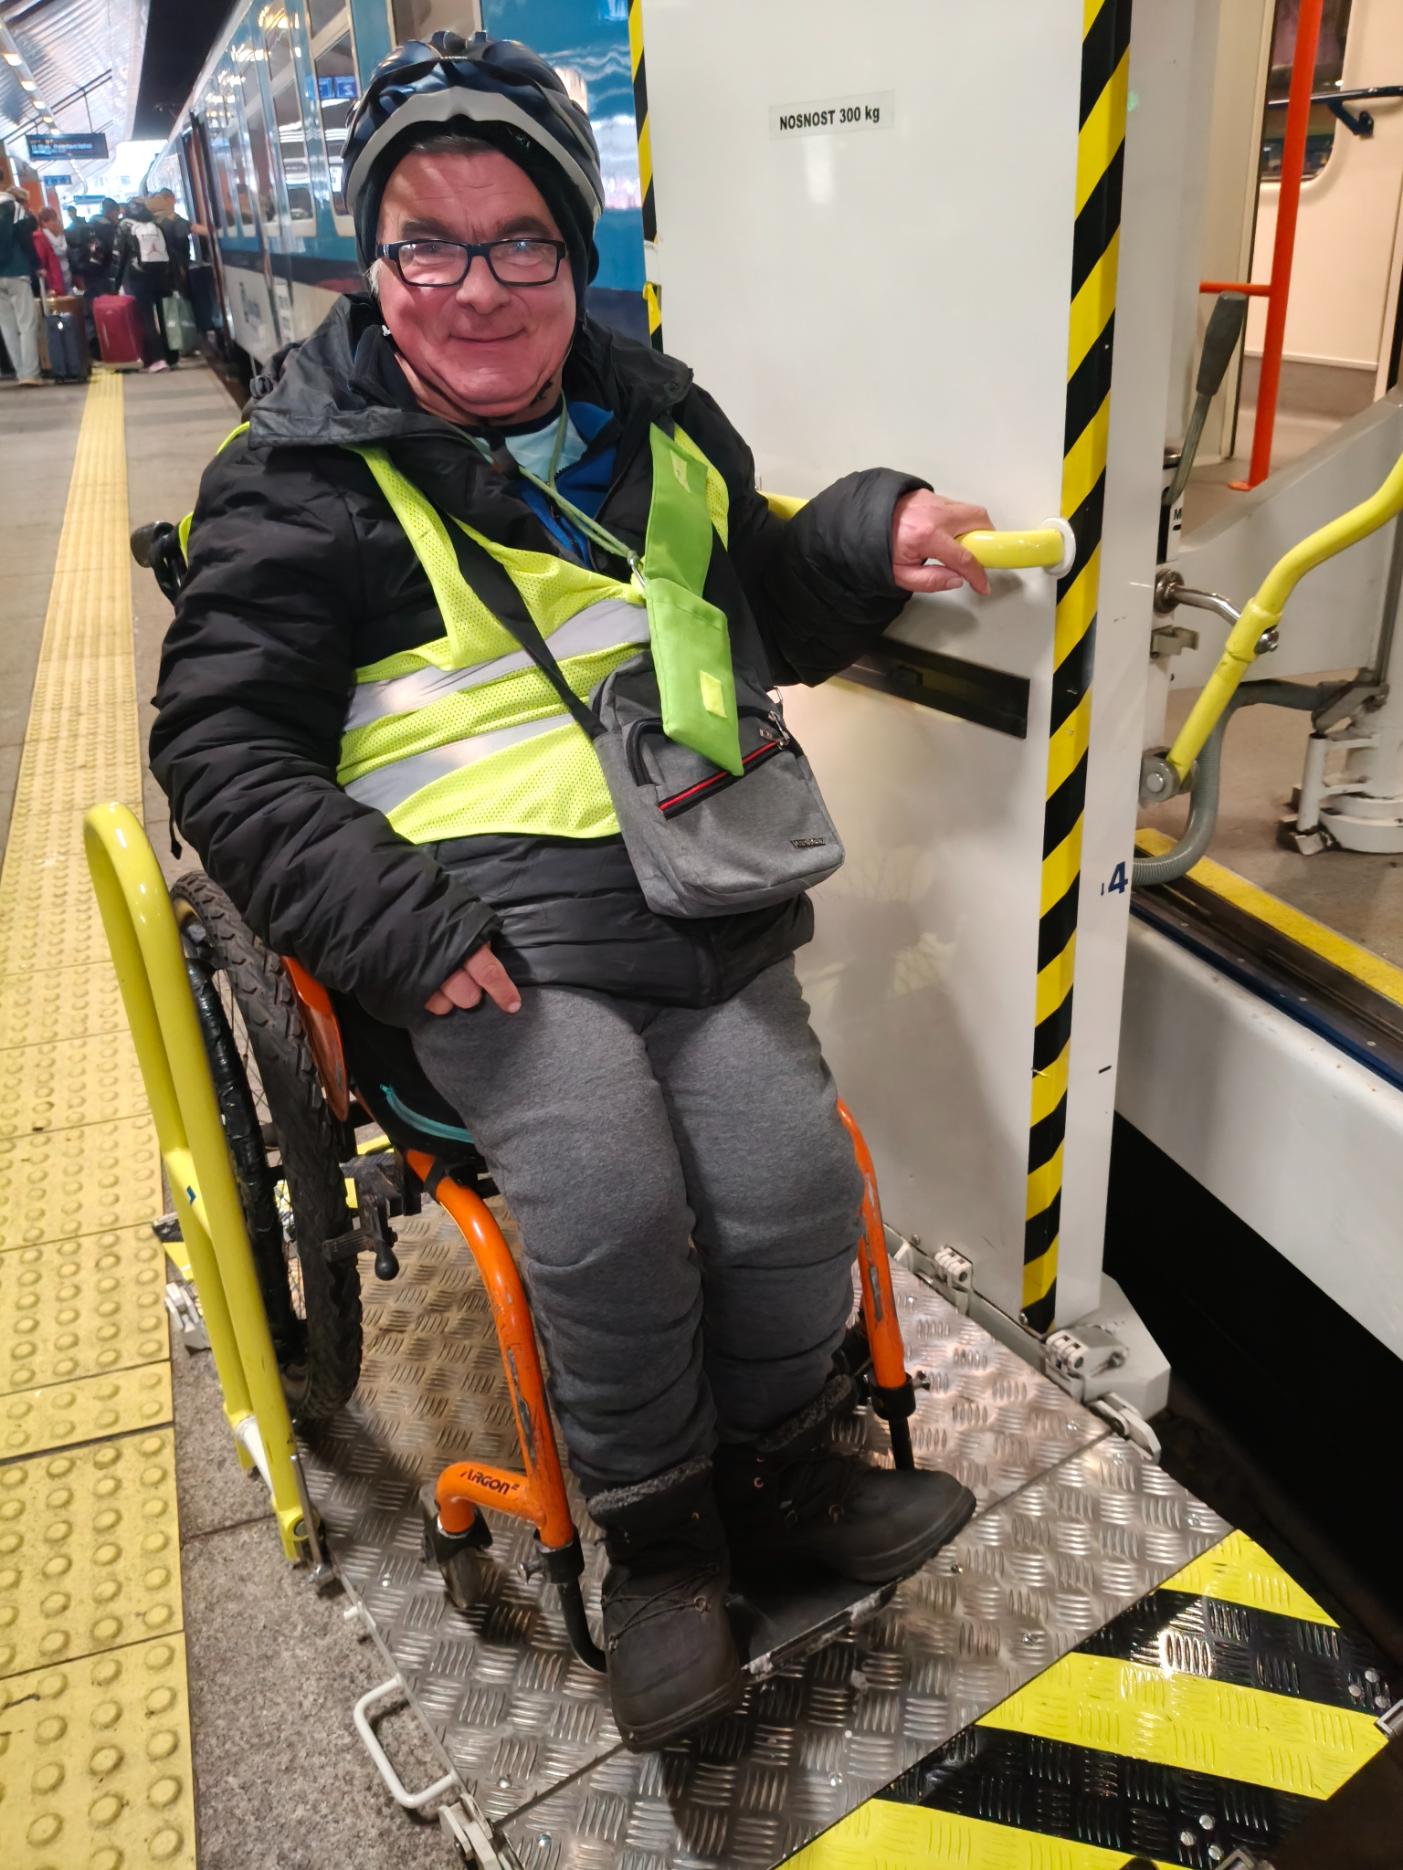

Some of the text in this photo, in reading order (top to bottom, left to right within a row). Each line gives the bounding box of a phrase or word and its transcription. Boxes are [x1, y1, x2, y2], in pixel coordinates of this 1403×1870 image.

[779, 105, 880, 131] NOSNOST 300 kg
